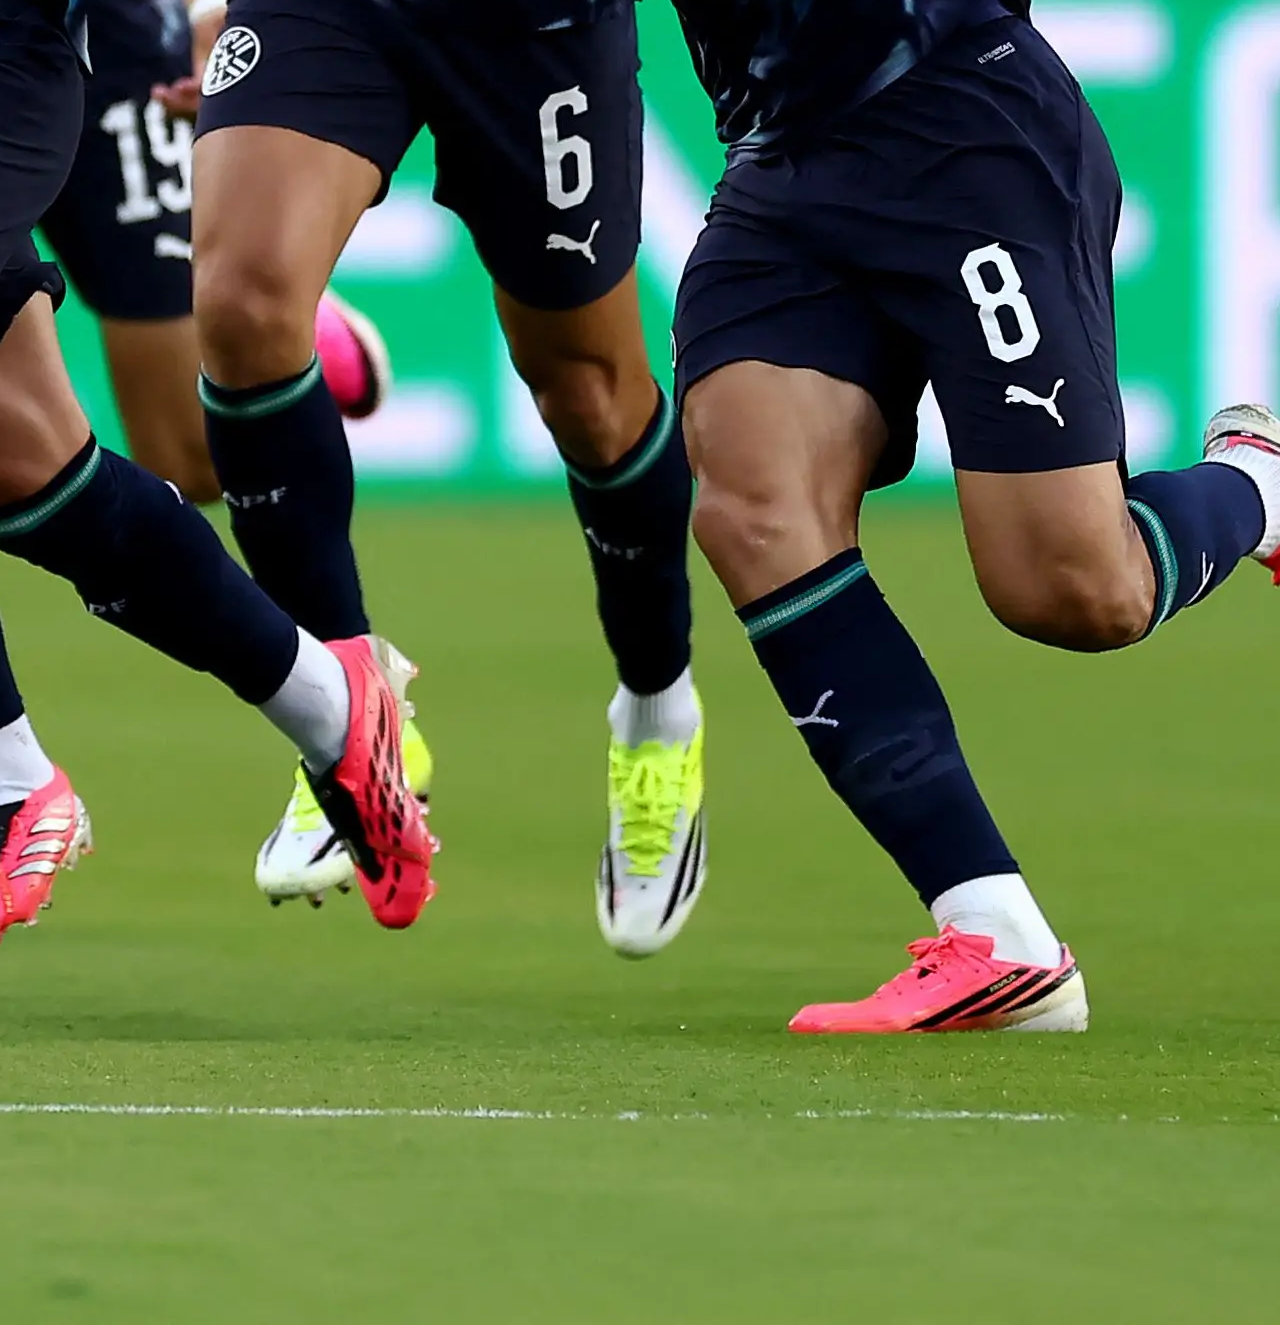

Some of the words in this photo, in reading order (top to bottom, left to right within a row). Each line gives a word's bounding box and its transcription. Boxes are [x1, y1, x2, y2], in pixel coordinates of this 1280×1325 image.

[100, 99, 193, 223] 19
[539, 85, 594, 211] 6
[960, 242, 1041, 363] 8
[89, 598, 126, 615] PF
